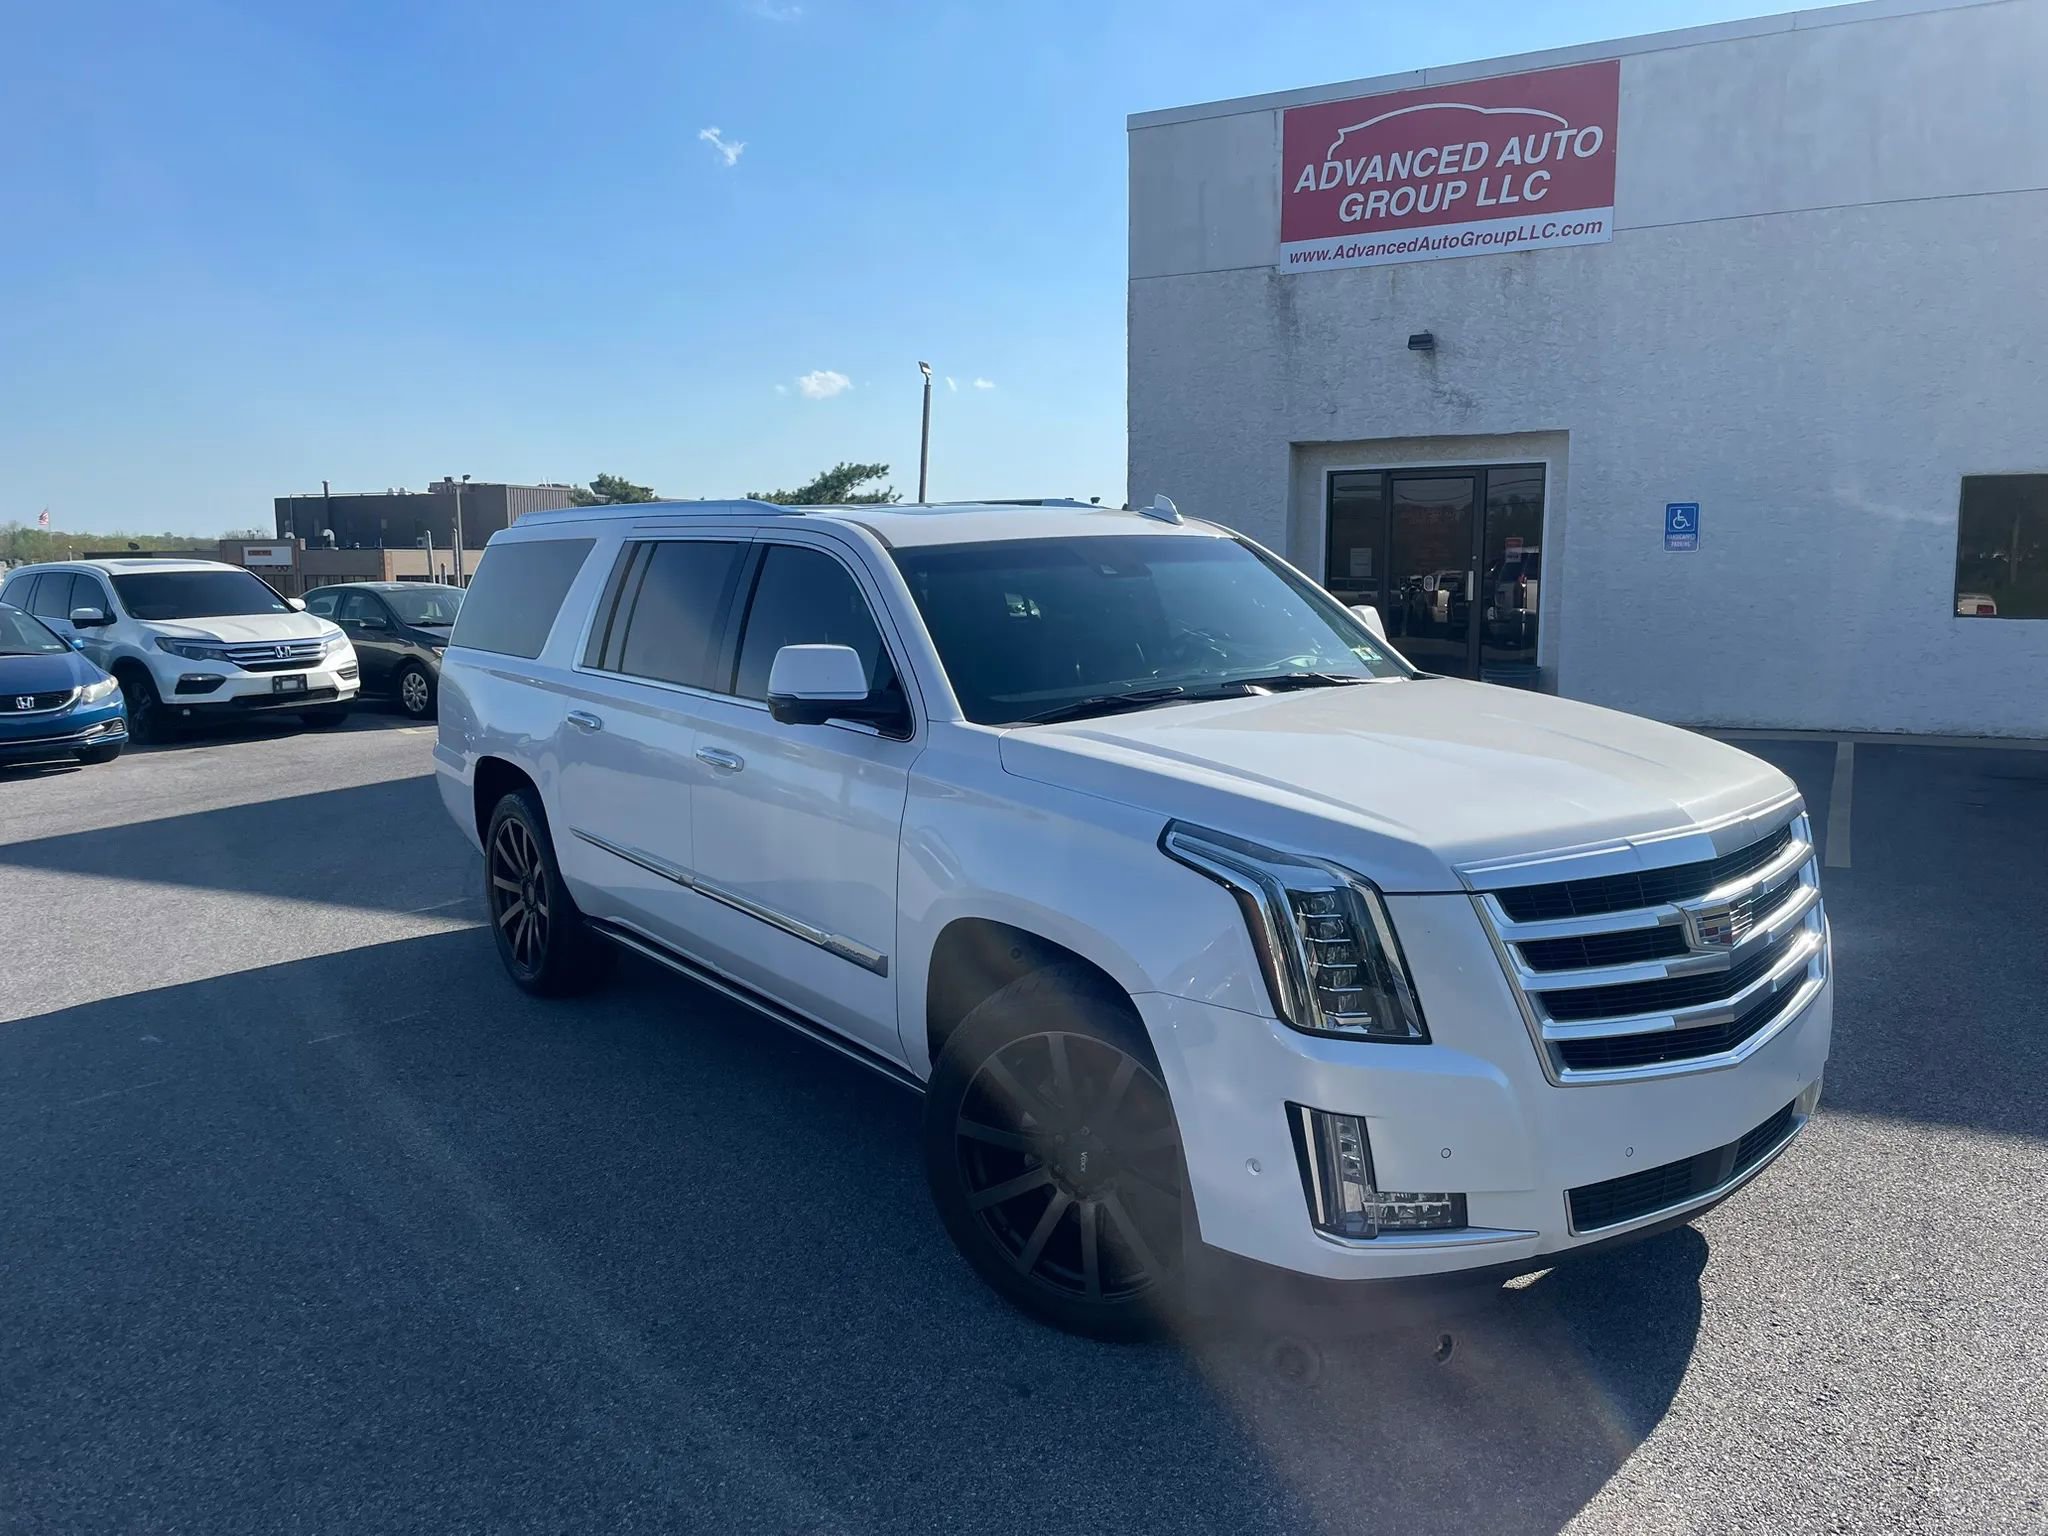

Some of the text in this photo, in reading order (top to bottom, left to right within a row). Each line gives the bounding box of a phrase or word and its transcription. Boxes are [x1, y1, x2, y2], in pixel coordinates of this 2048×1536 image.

[1294, 126, 1604, 193] ADVANCED AUTO
[1338, 170, 1551, 223] GROUP LLC
[1289, 221, 1603, 264] www.AdvancedAutoGroupLLC.com
